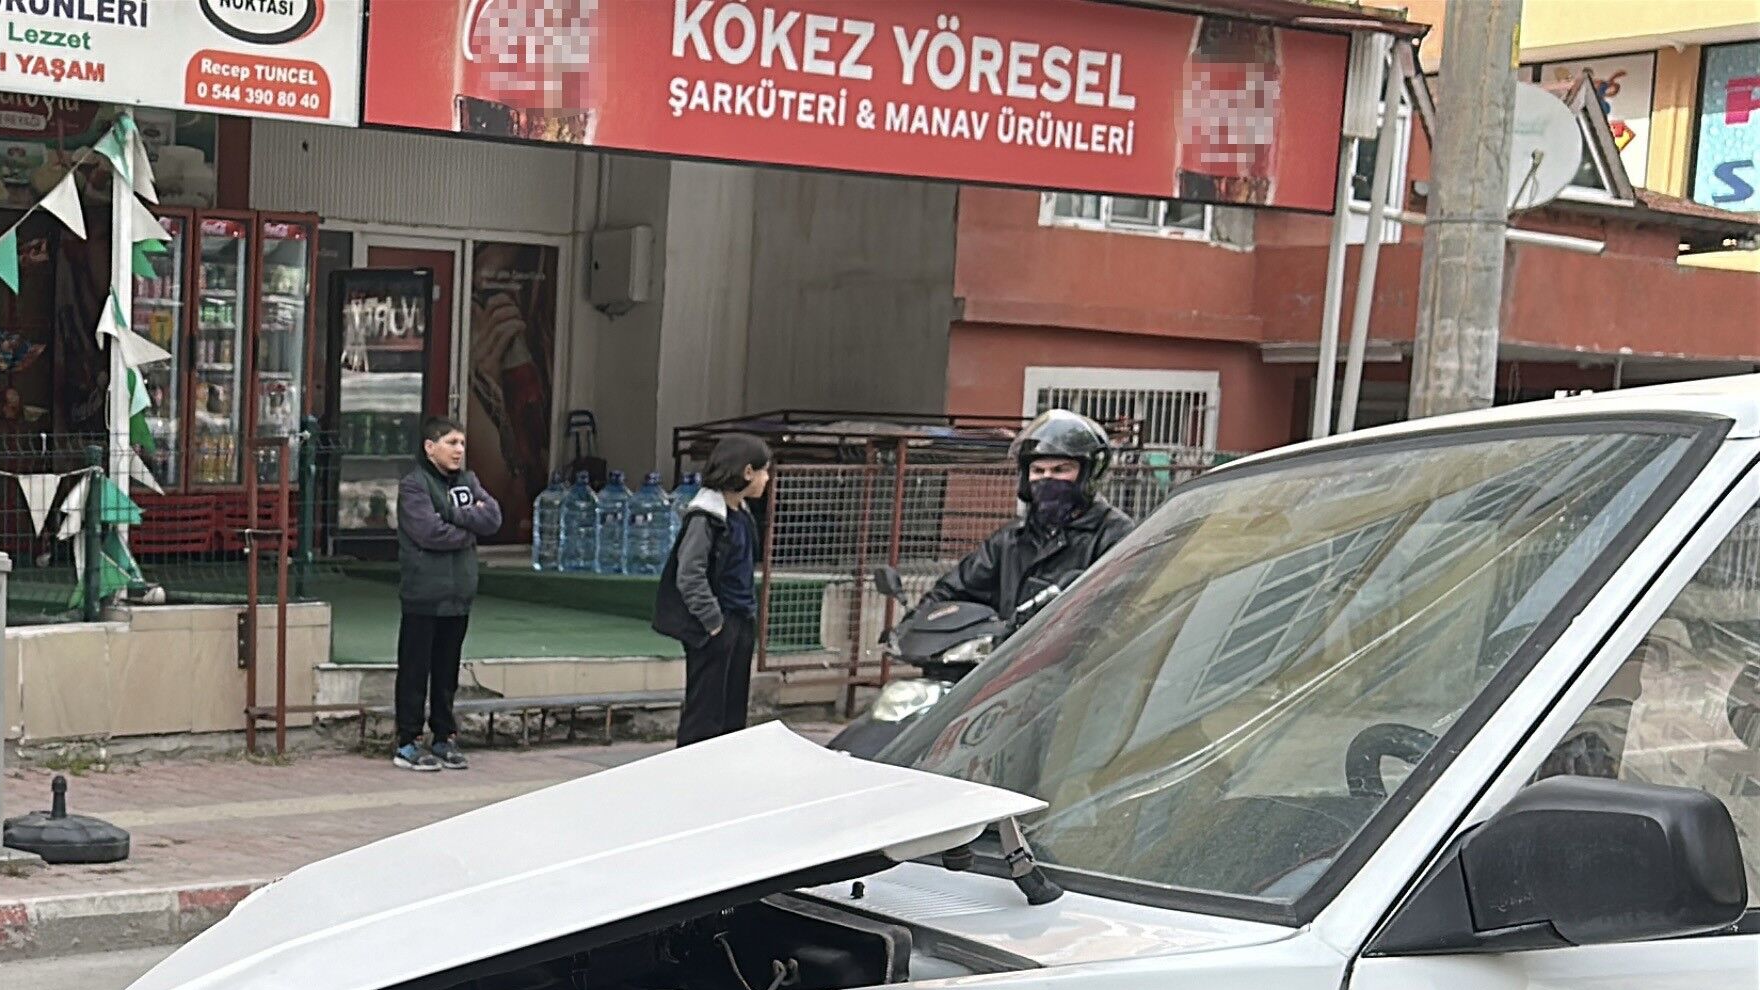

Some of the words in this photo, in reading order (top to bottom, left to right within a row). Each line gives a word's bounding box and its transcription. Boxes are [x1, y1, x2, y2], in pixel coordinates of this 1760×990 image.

[8, 21, 91, 50] Lezzet
[16, 53, 106, 82] YAŞAM
[201, 58, 251, 82] Recep
[254, 64, 318, 85] TUNCEL
[892, 14, 1136, 111] YÖRESEL
[197, 82, 208, 98] 0
[212, 83, 241, 101] 544
[245, 87, 274, 105] 390
[277, 90, 296, 107] 80
[300, 93, 320, 110] 40
[668, 77, 848, 127] ŞARKÜTERİ
[855, 98, 876, 130] &
[884, 102, 990, 142] MANAV
[996, 107, 1135, 156] ÜRÜNLERİ
